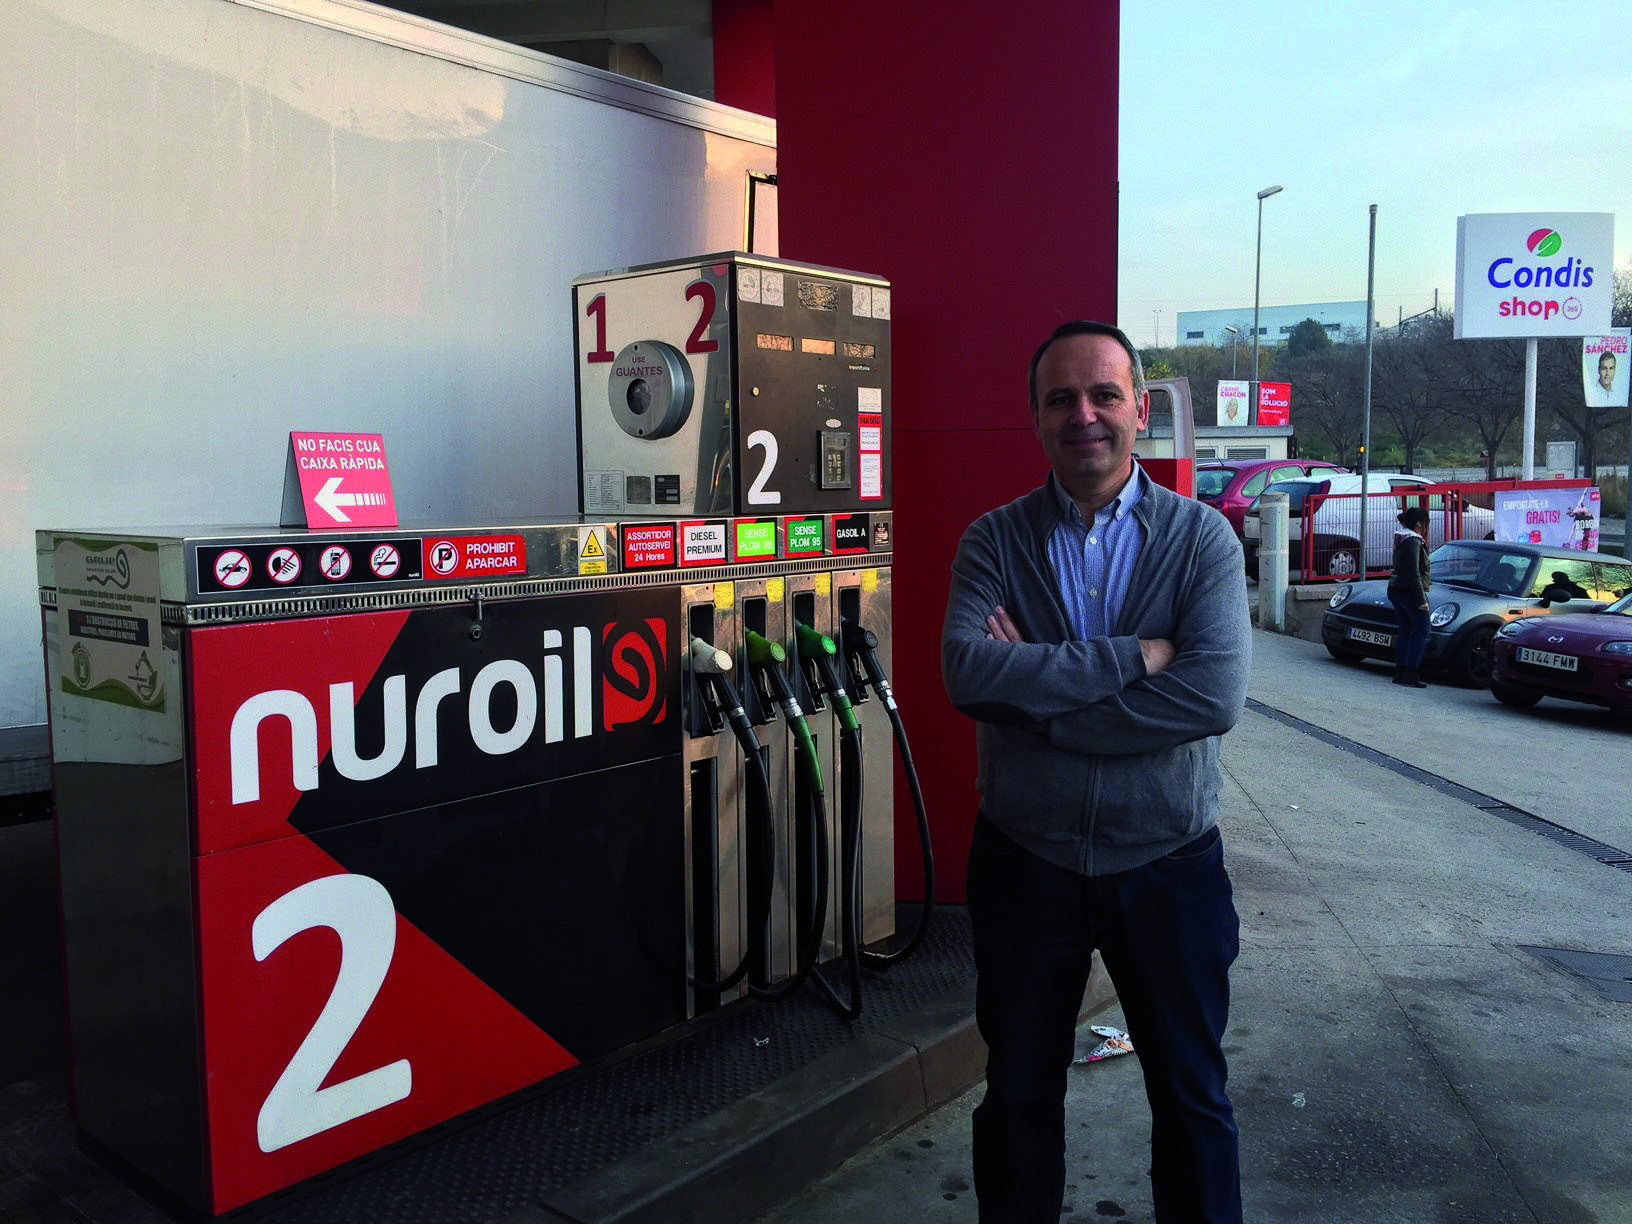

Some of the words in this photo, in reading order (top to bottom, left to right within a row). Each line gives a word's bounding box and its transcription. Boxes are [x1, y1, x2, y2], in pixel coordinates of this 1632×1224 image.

[1488, 257, 1594, 289] Condis
[1500, 296, 1560, 320] shop
[686, 282, 718, 354] 2
[587, 294, 615, 363] 1
[1600, 336, 1628, 344] PEDRO
[1585, 343, 1628, 354] SÁNCHEZ
[616, 366, 663, 377] GUANTES
[298, 438, 316, 452] NO
[319, 440, 354, 452] FACIS
[356, 440, 381, 452] CUA
[300, 456, 338, 470] CAIXA
[340, 454, 385, 470] RÀPIDA
[747, 430, 781, 505] 2
[1526, 510, 1560, 525] GRATIS!
[627, 530, 671, 540] ASSORTIDOR
[745, 528, 768, 538] SENSE
[794, 526, 816, 535] SENSE
[836, 528, 859, 538] GASOIL
[861, 528, 866, 537] A
[691, 532, 717, 541] DIESEL
[628, 541, 671, 552] AUTOSERVEI
[740, 541, 760, 551] PLOM
[790, 538, 809, 548] PLOM
[813, 537, 821, 546] 95
[466, 542, 515, 555] PROHIBIT
[588, 545, 598, 554] Ex
[687, 544, 722, 555] PREMIUM
[86, 556, 115, 564] GRUP
[465, 556, 517, 570] APARCAR
[634, 554, 643, 562] 24
[646, 553, 665, 561] Hores
[1352, 630, 1370, 640] 4492
[1374, 634, 1390, 644] BSM
[1523, 650, 1549, 664] 3144
[1553, 656, 1576, 669] FMW
[230, 626, 593, 805] nuroil
[252, 873, 412, 1154] 2
